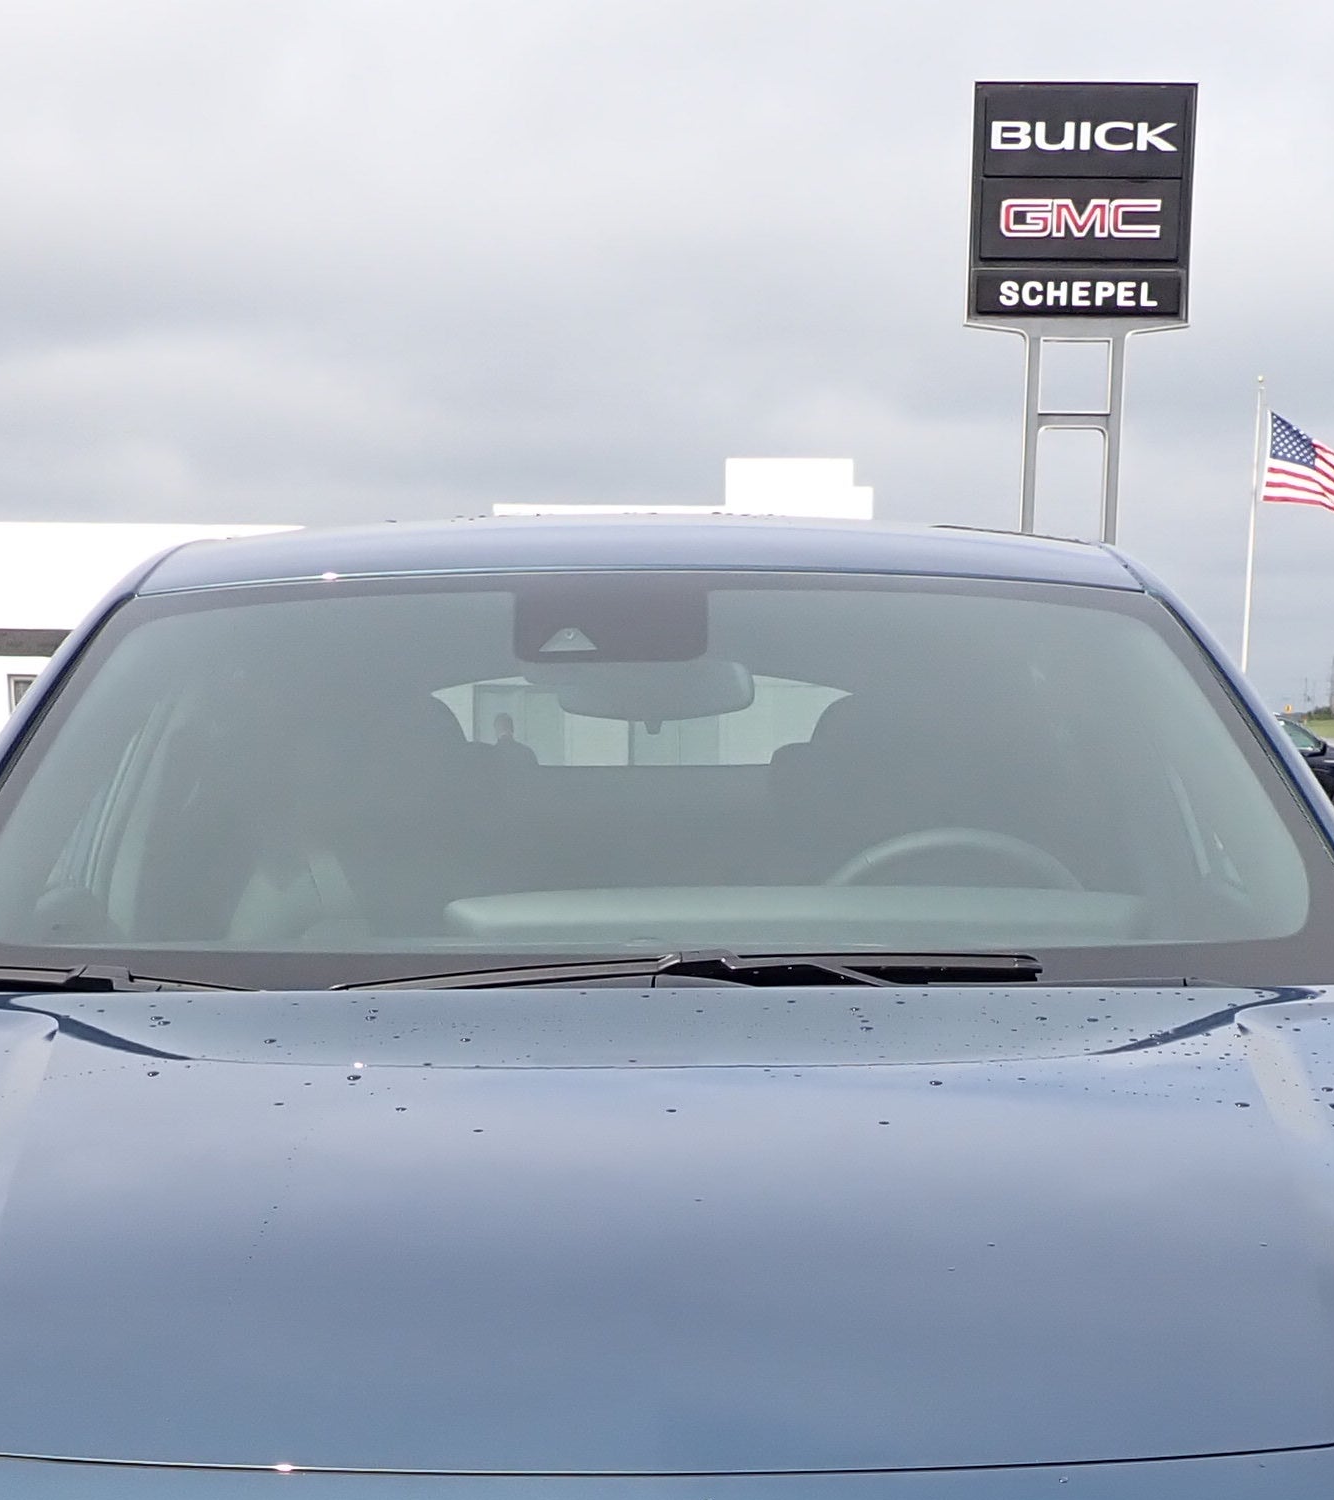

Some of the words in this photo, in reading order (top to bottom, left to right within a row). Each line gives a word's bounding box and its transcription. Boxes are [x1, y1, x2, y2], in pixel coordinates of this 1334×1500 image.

[991, 121, 1177, 151] BUICK
[1000, 198, 1161, 238] GMC
[999, 280, 1158, 307] SCHEPEL
